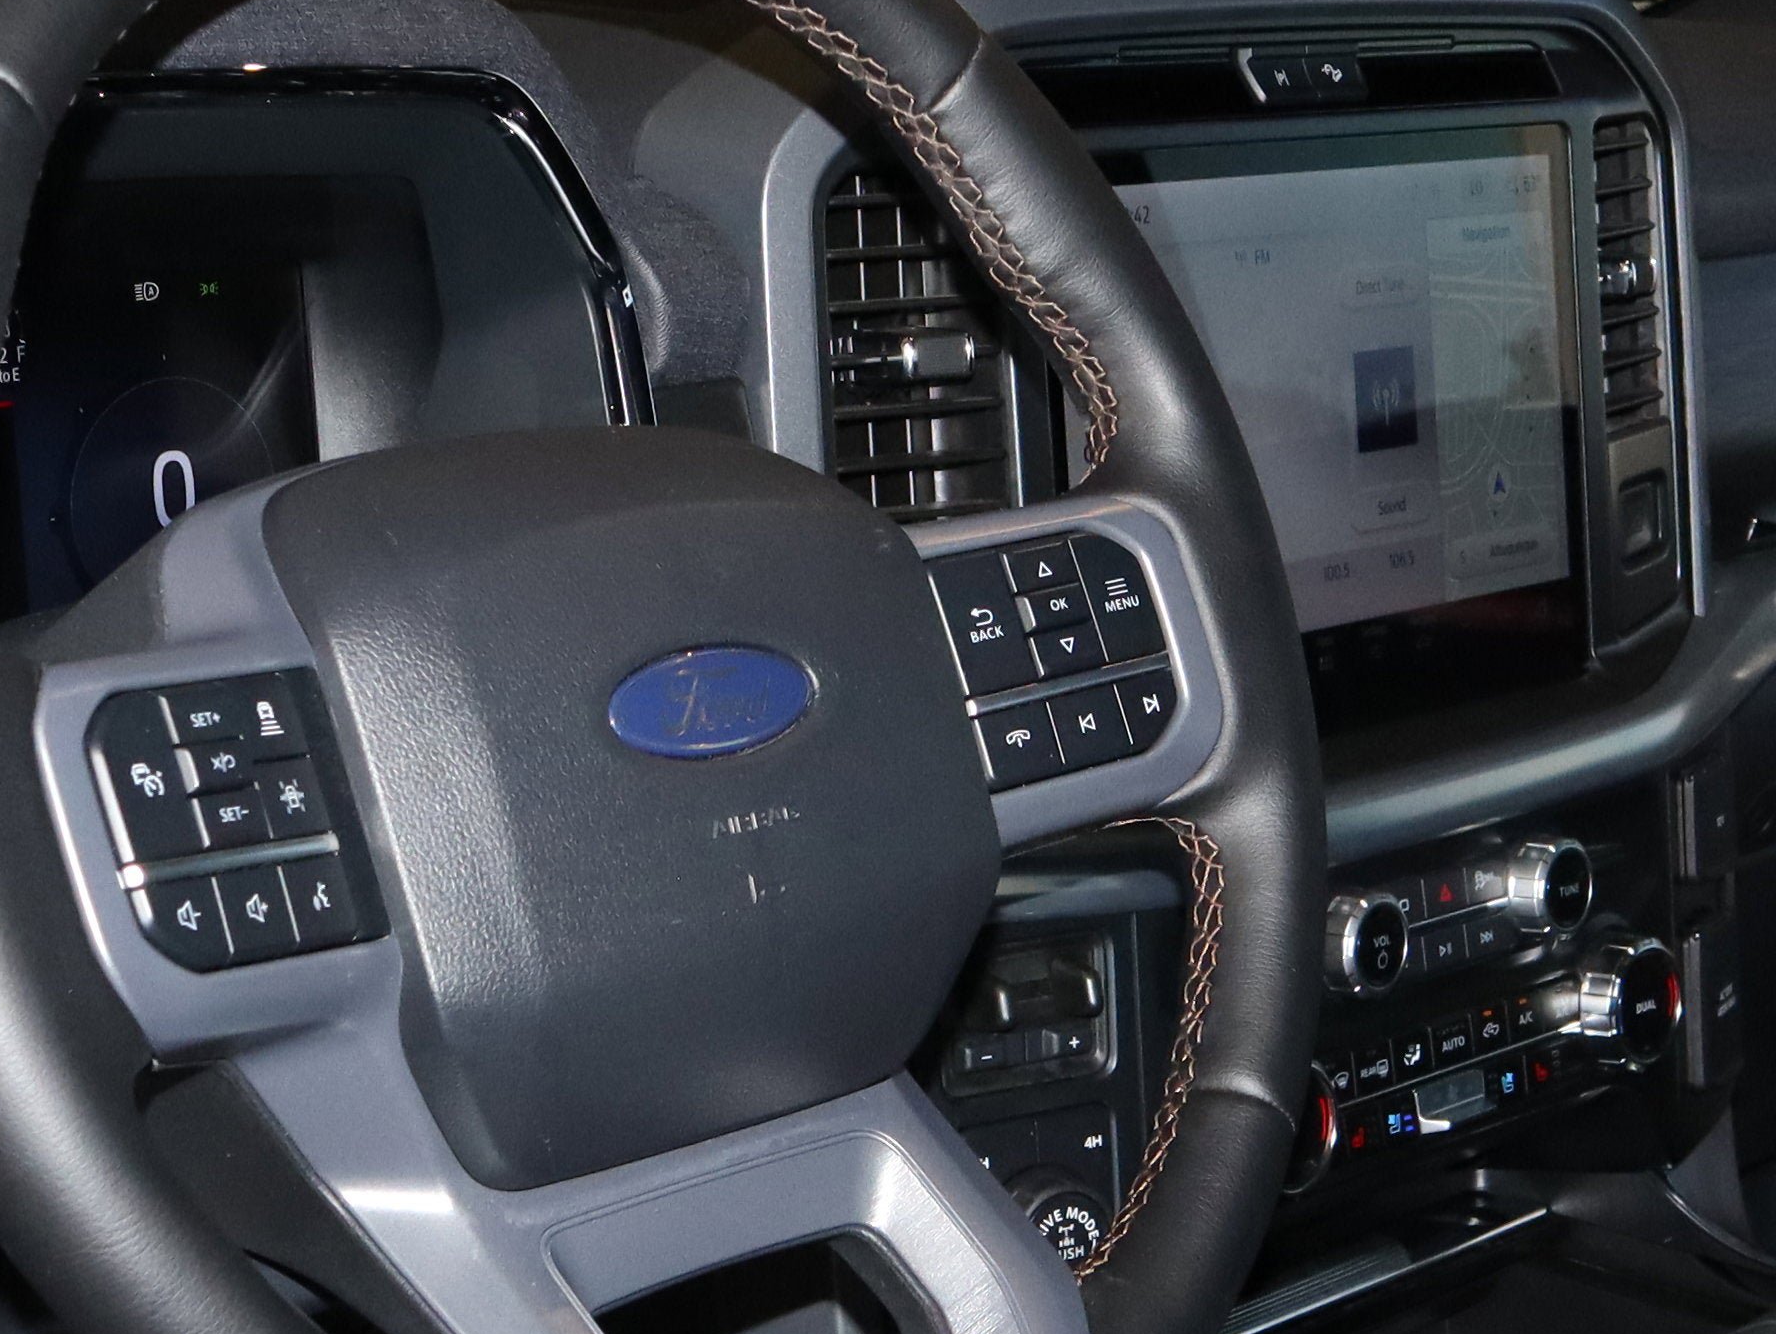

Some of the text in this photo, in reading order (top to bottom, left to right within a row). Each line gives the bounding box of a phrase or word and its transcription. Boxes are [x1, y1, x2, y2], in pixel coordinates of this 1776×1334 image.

[153, 449, 196, 528] 0
[1049, 597, 1069, 611] OK
[1104, 595, 1140, 613] MENU
[970, 625, 1005, 644] BACK
[1373, 935, 1392, 949] VOL
[1636, 999, 1657, 1015] DUAL
[1519, 1011, 1534, 1025] A/C
[1441, 1034, 1465, 1054] AUTO
[1083, 1134, 1103, 1149] 4H
[1065, 1206, 1100, 1241] MODE
